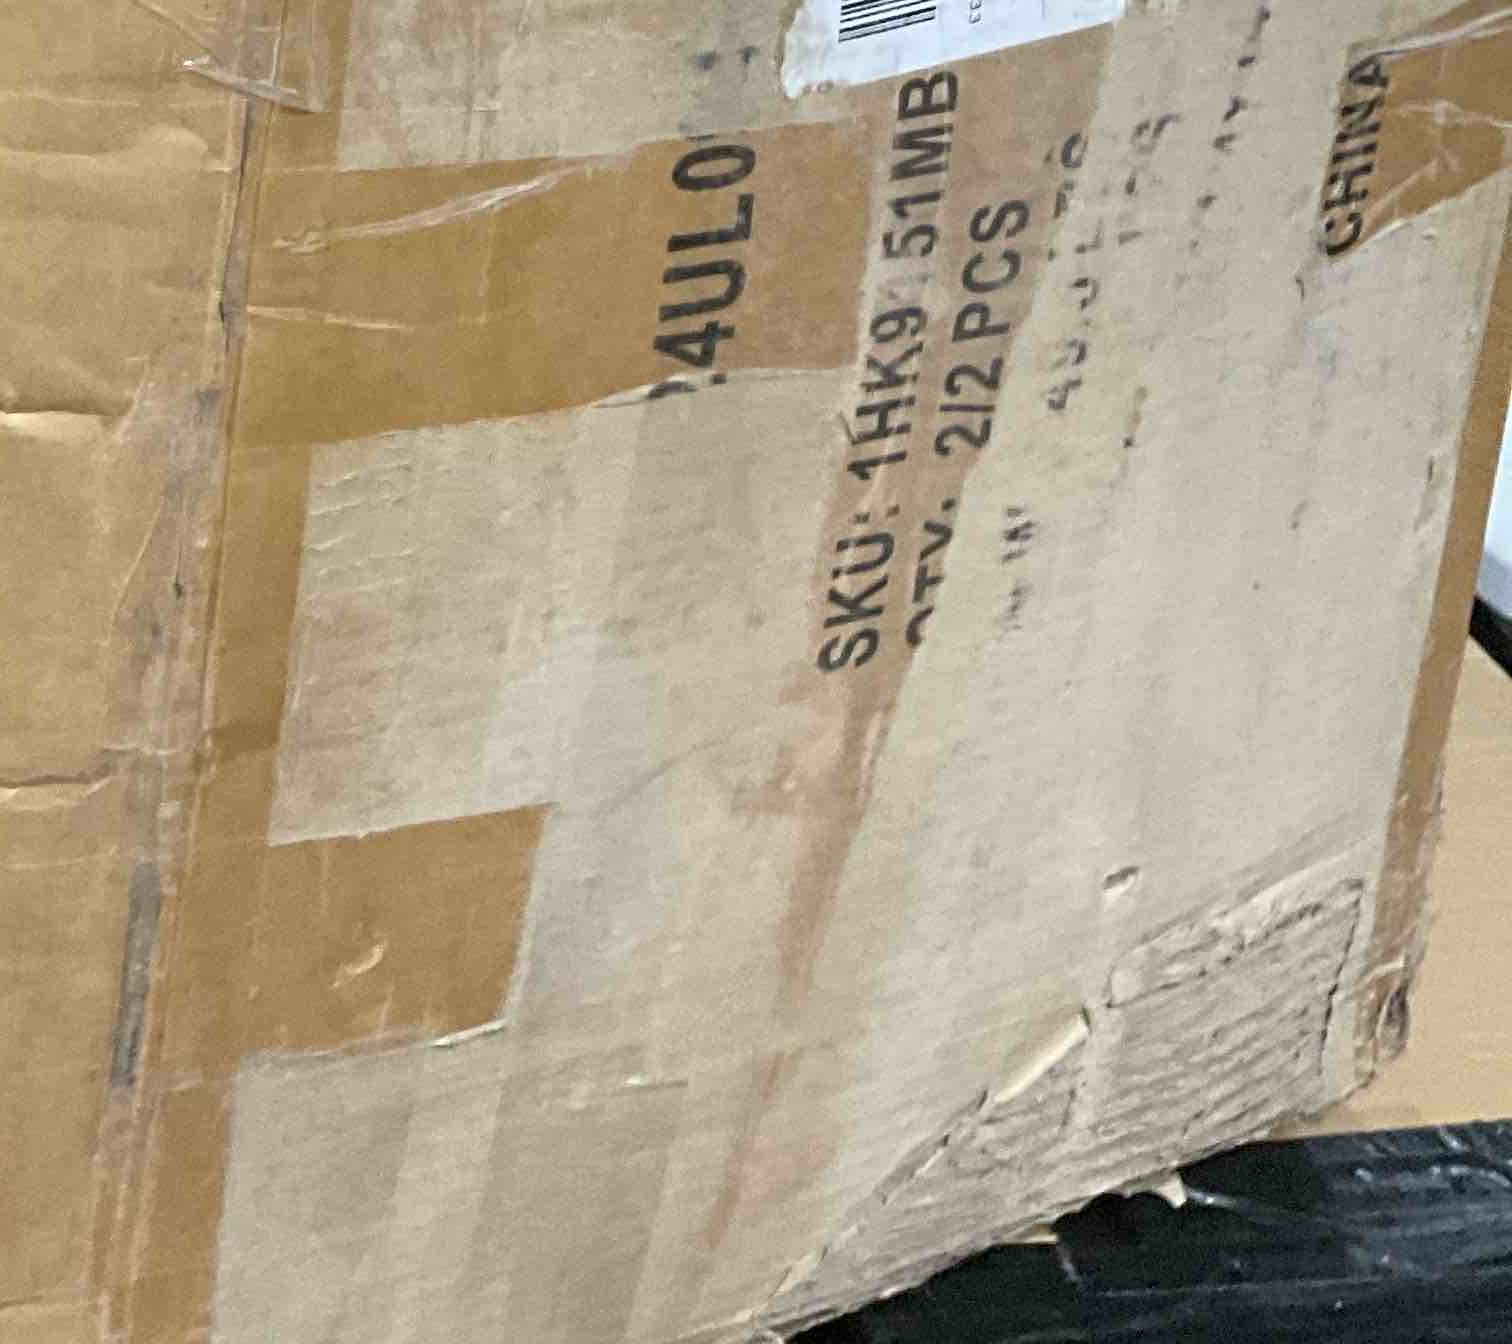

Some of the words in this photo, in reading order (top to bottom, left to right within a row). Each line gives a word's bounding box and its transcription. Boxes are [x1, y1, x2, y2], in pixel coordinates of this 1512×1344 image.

[1320, 50, 1389, 256] CHINA
[952, 198, 1031, 341] PCS
[815, 502, 901, 675] SKU:
